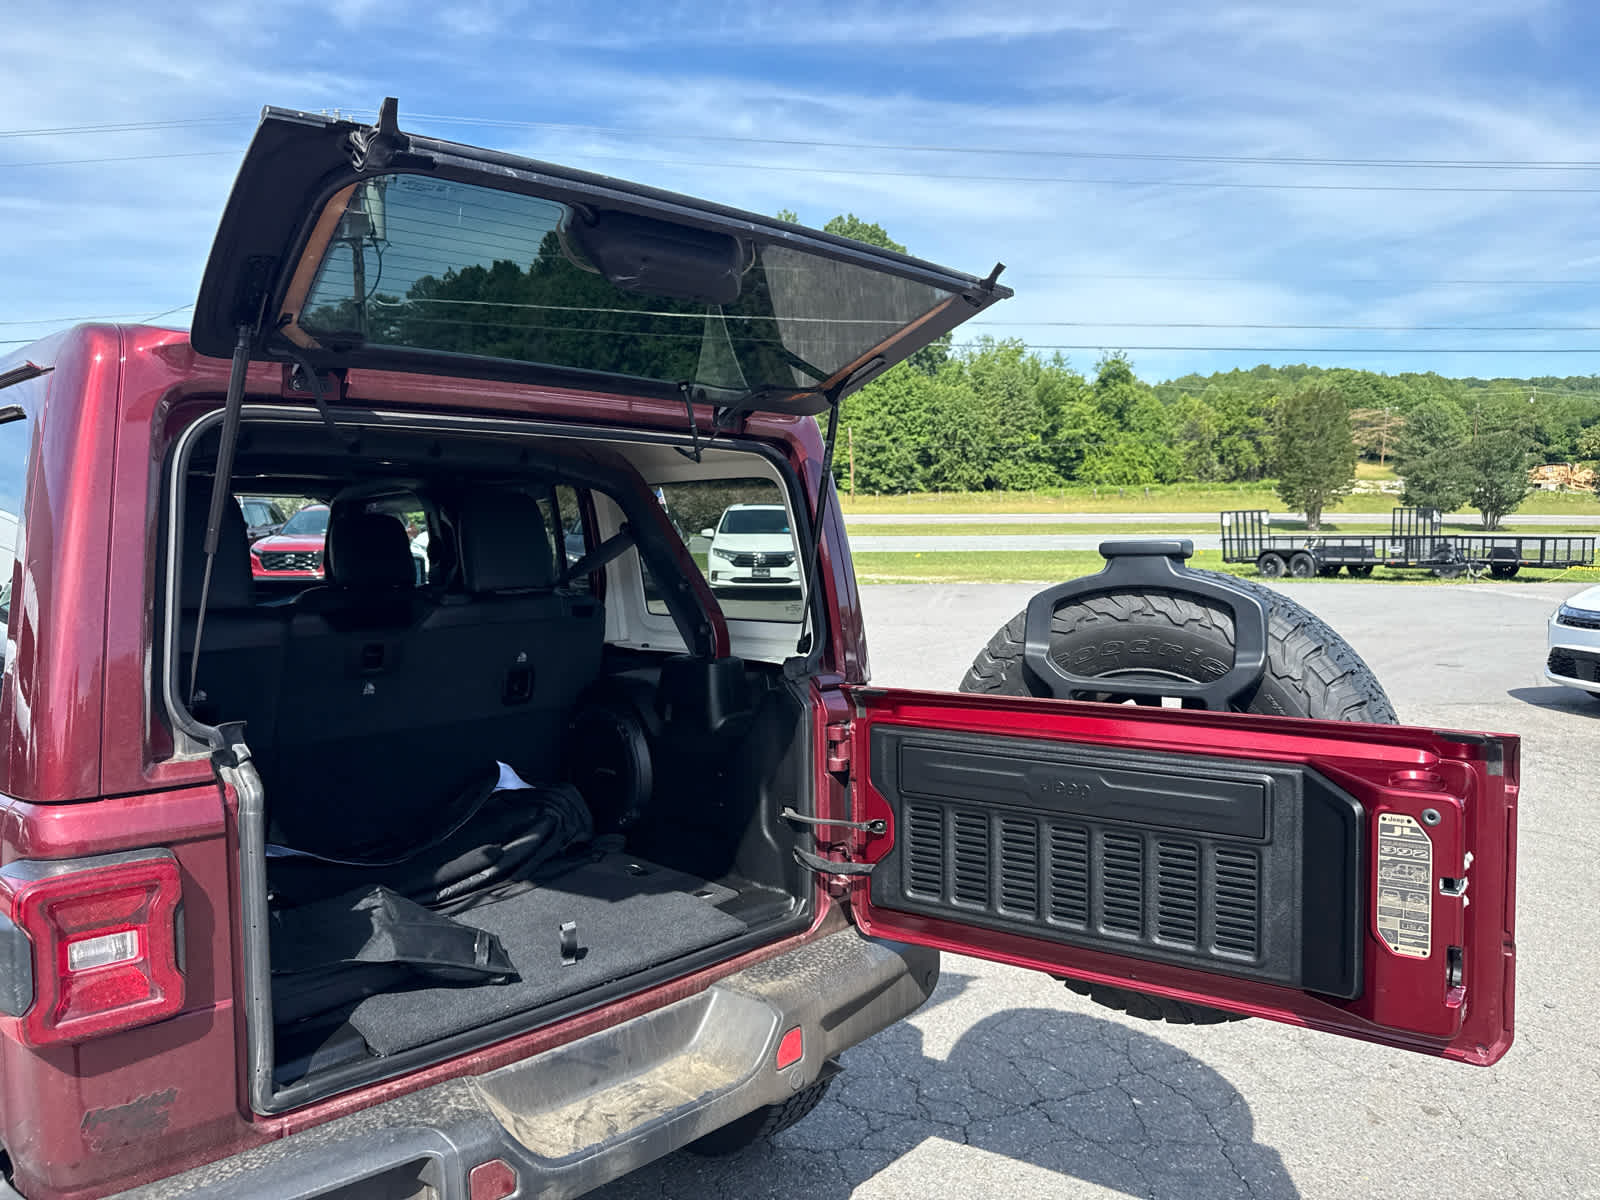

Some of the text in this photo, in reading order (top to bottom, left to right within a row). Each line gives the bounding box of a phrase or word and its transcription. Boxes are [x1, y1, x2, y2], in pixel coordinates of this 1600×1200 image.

[1388, 816, 1404, 824] Jeep
[1381, 846, 1428, 858] 392
[1402, 923, 1425, 932] USA
